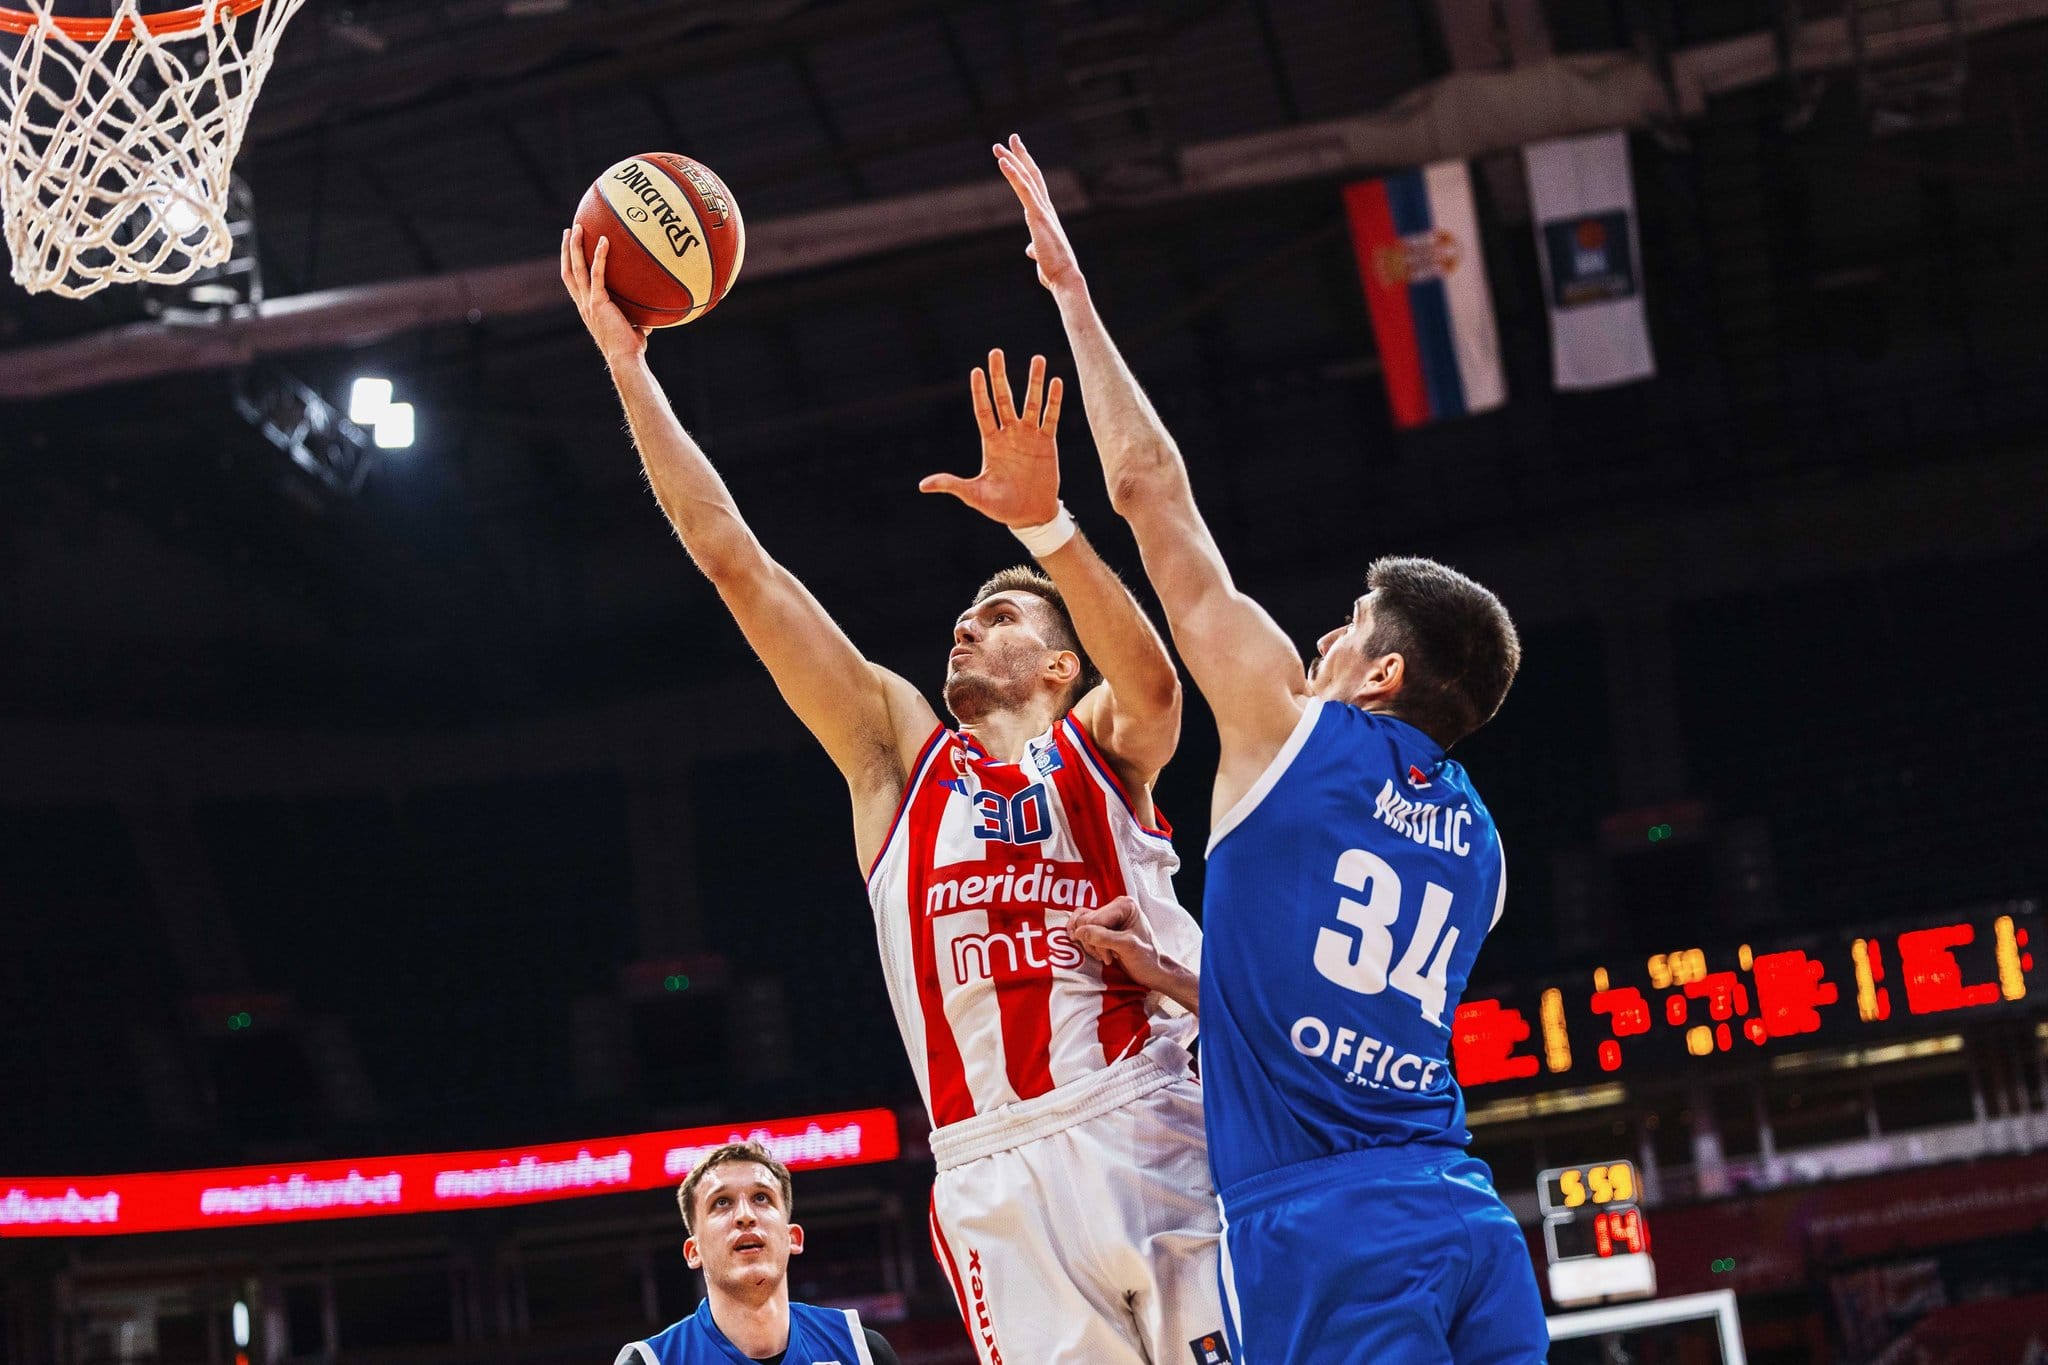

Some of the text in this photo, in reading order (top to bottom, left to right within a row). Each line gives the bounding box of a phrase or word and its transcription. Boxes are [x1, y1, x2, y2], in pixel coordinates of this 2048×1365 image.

[614, 163, 700, 258] SPALDING
[973, 782, 1053, 845] 30
[925, 863, 1098, 917] meridian
[952, 920, 1085, 985] mts
[1313, 848, 1461, 1028] 34
[1594, 1209, 1642, 1258] 14
